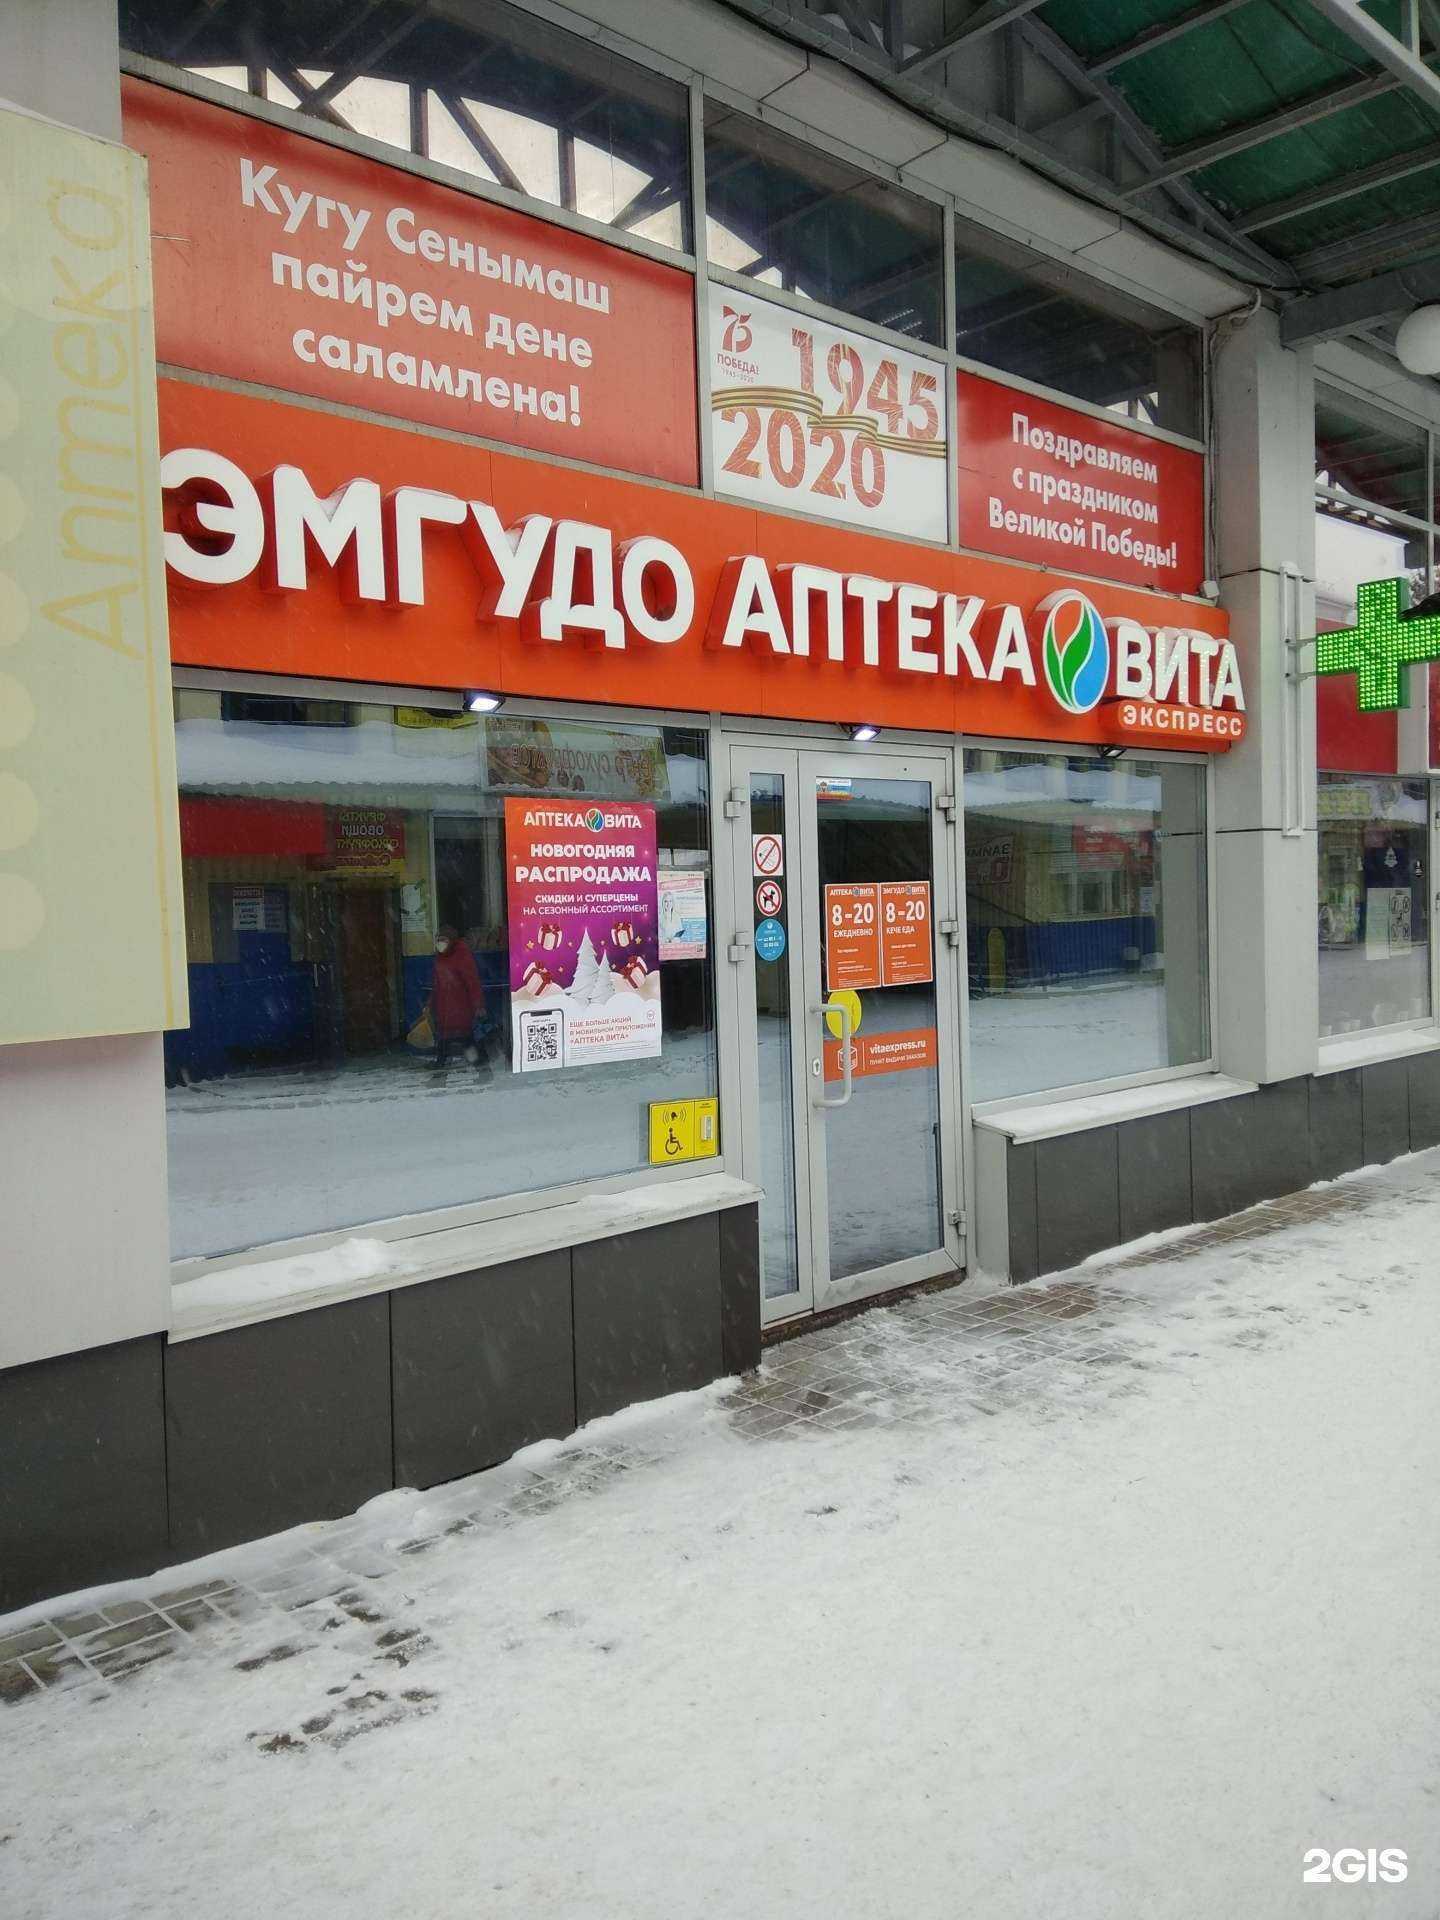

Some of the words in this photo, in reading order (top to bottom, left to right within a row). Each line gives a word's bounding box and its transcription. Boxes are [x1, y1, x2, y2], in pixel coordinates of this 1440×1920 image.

[240, 157, 372, 251] Кугу
[386, 207, 610, 315] Сенымаш
[271, 251, 474, 337] пайрем
[485, 313, 593, 368] дене
[292, 328, 582, 427] саламлена!
[716, 353, 760, 376] ПОБЕДА!
[791, 327, 939, 441] 1945
[720, 406, 887, 509] 2020
[1012, 412, 1159, 484] Поздравляем
[1012, 467, 1025, 490] с
[1029, 471, 1159, 524] праздником
[989, 496, 1087, 548] Великой
[1091, 521, 1178, 569] Победы!
[160, 448, 695, 650] ЭМГУДО
[722, 555, 1037, 688] АПТЕКА
[1116, 625, 1247, 711] ВИТА
[1122, 704, 1243, 737] ЭКСПРЕСС
[523, 811, 586, 828] АПТЕКА
[604, 814, 643, 829] ВИТА
[530, 843, 636, 860] НОВОГОДНЯЯ
[515, 866, 652, 884] РАСПРОДАЖА
[523, 907, 537, 915] НА
[538, 904, 589, 915] СЕЗОННЫЙ
[590, 904, 648, 914] АССОРТИМЕНТ
[534, 894, 575, 904] СКИДКИ
[577, 894, 583, 902] И
[585, 893, 639, 902] СУПЕРЦЕНЫ
[833, 928, 874, 938] ЕЖЕДНЕВНО
[869, 1039, 927, 1054] vitaexpress.ru
